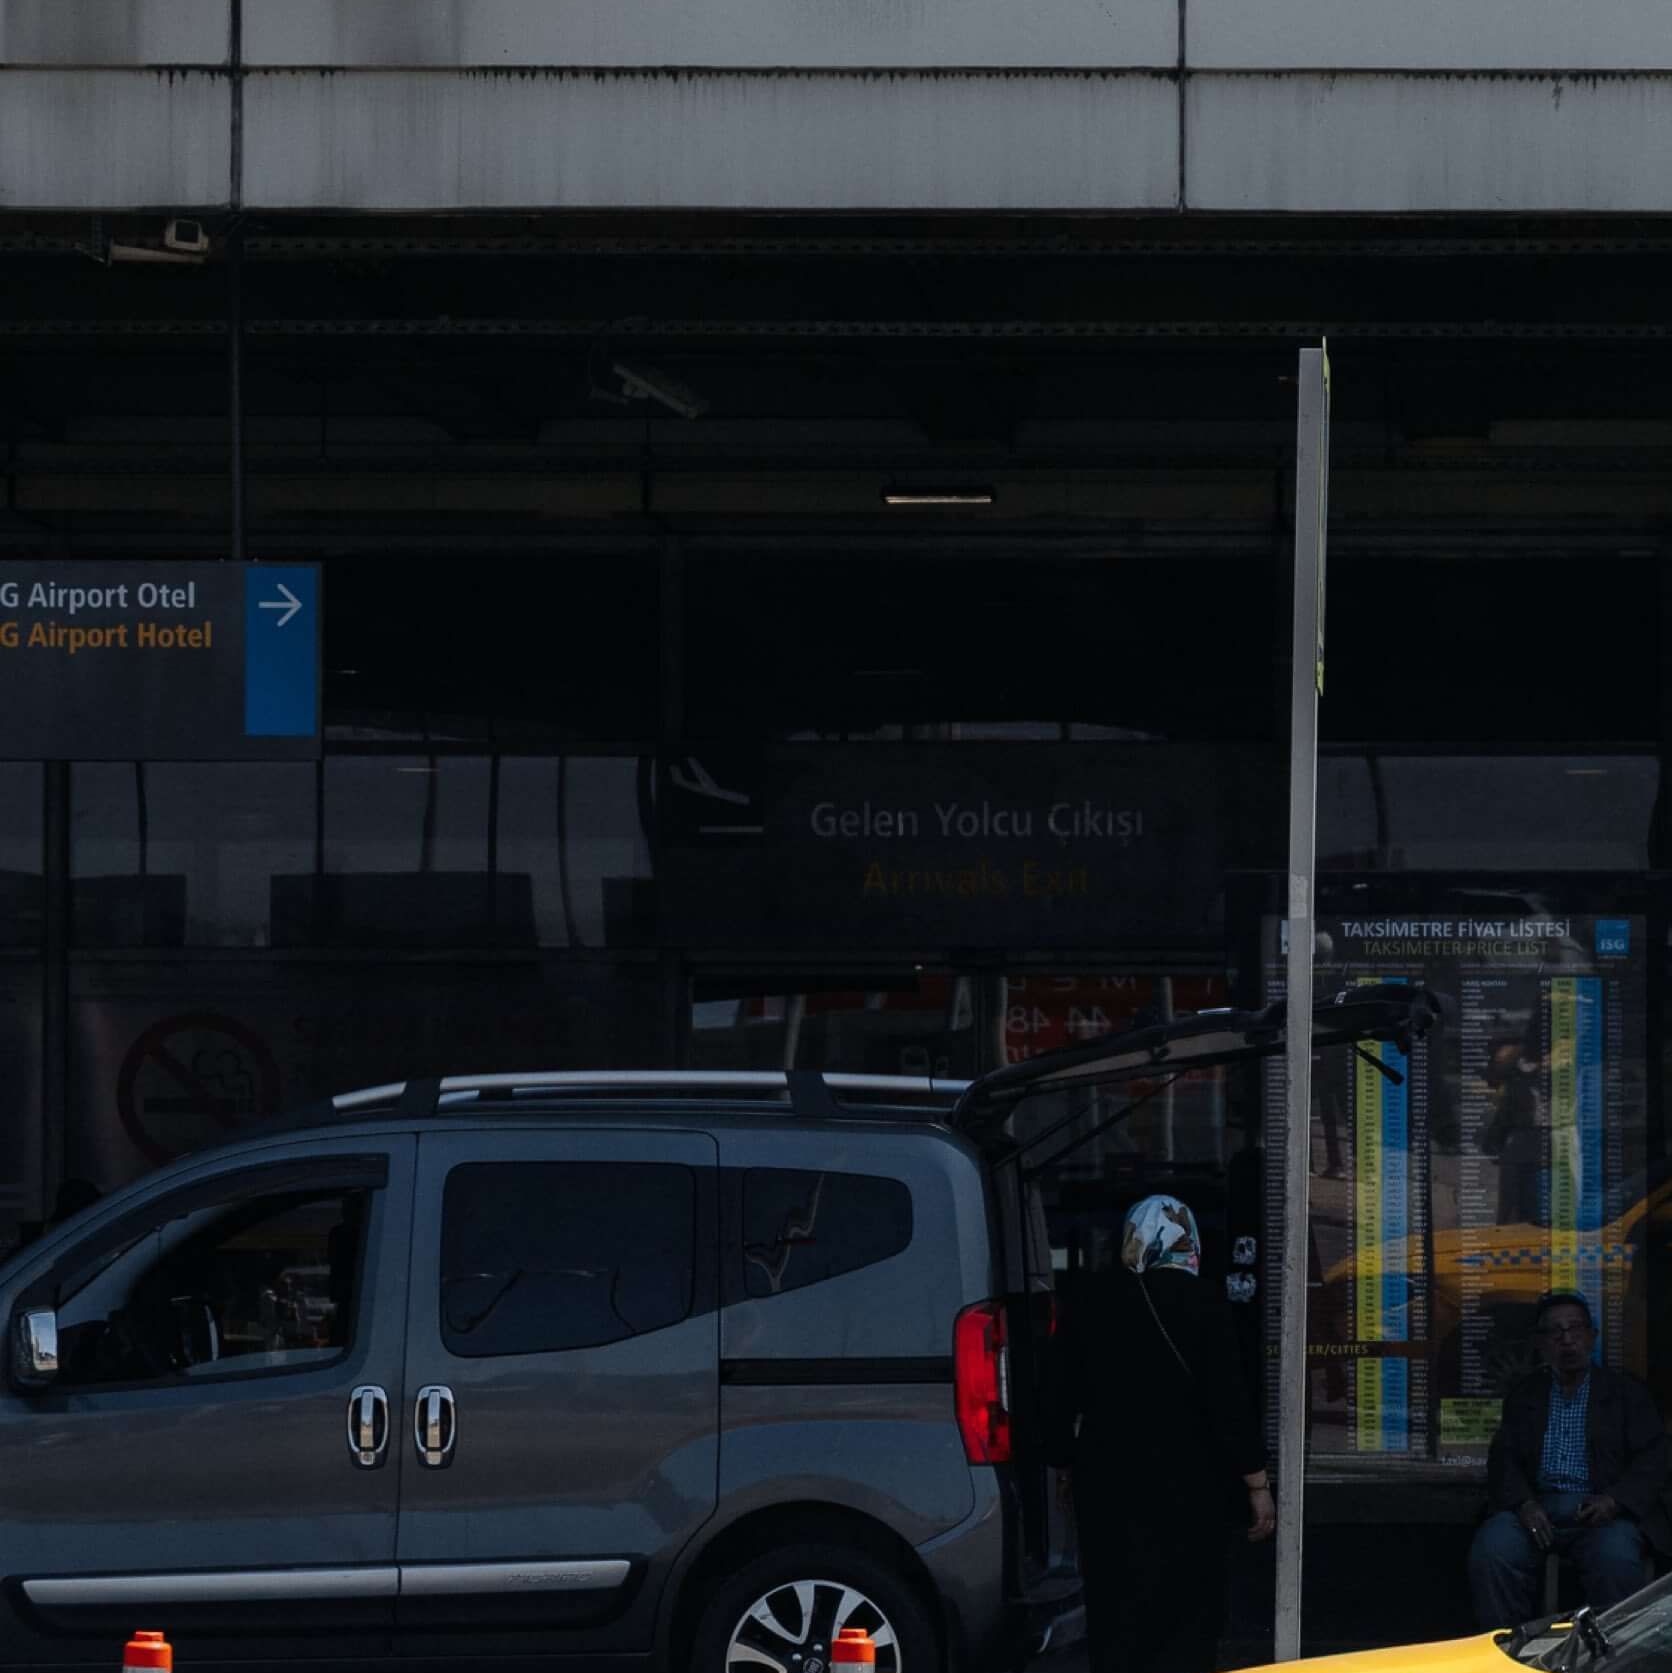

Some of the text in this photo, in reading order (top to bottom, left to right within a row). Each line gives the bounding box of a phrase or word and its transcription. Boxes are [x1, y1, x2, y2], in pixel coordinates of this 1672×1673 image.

[27, 581, 128, 615] Airport
[137, 581, 195, 609] Otel
[27, 621, 128, 655] Airport
[137, 620, 213, 649] Hotel
[811, 800, 1143, 847] Gelen Yolcu Çıkışı
[1342, 917, 1570, 937] TAKSİMETRE FİYAT LİSTESİ
